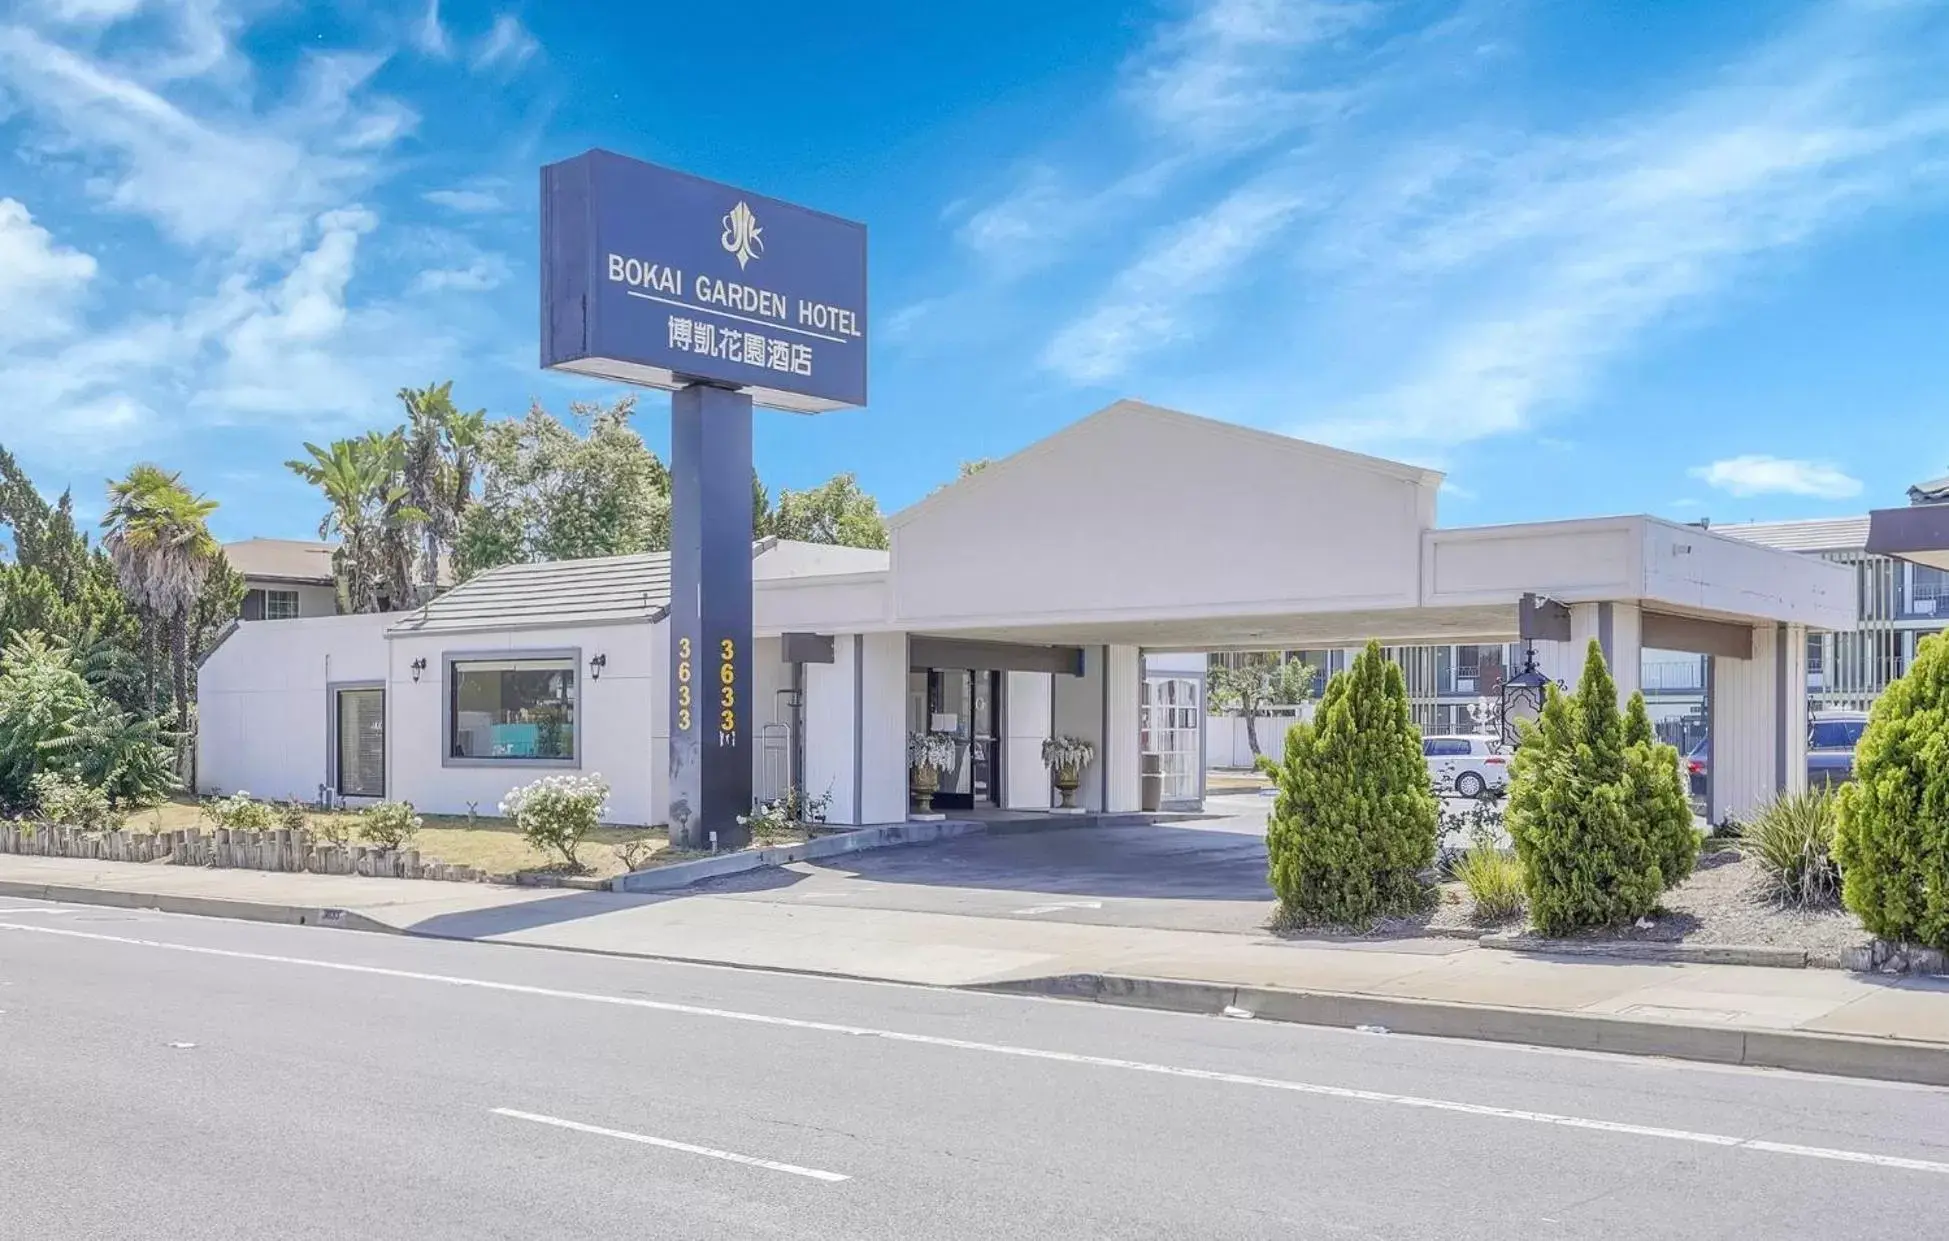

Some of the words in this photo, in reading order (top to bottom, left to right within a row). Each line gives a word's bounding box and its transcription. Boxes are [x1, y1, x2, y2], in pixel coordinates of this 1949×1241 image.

[608, 253, 682, 296] BOKAI
[695, 275, 786, 320] GARDEN
[799, 300, 862, 337] HOTEL
[668, 315, 812, 376] 博凱花園酒店
[679, 637, 691, 730] 3633
[720, 639, 734, 731] 3633
